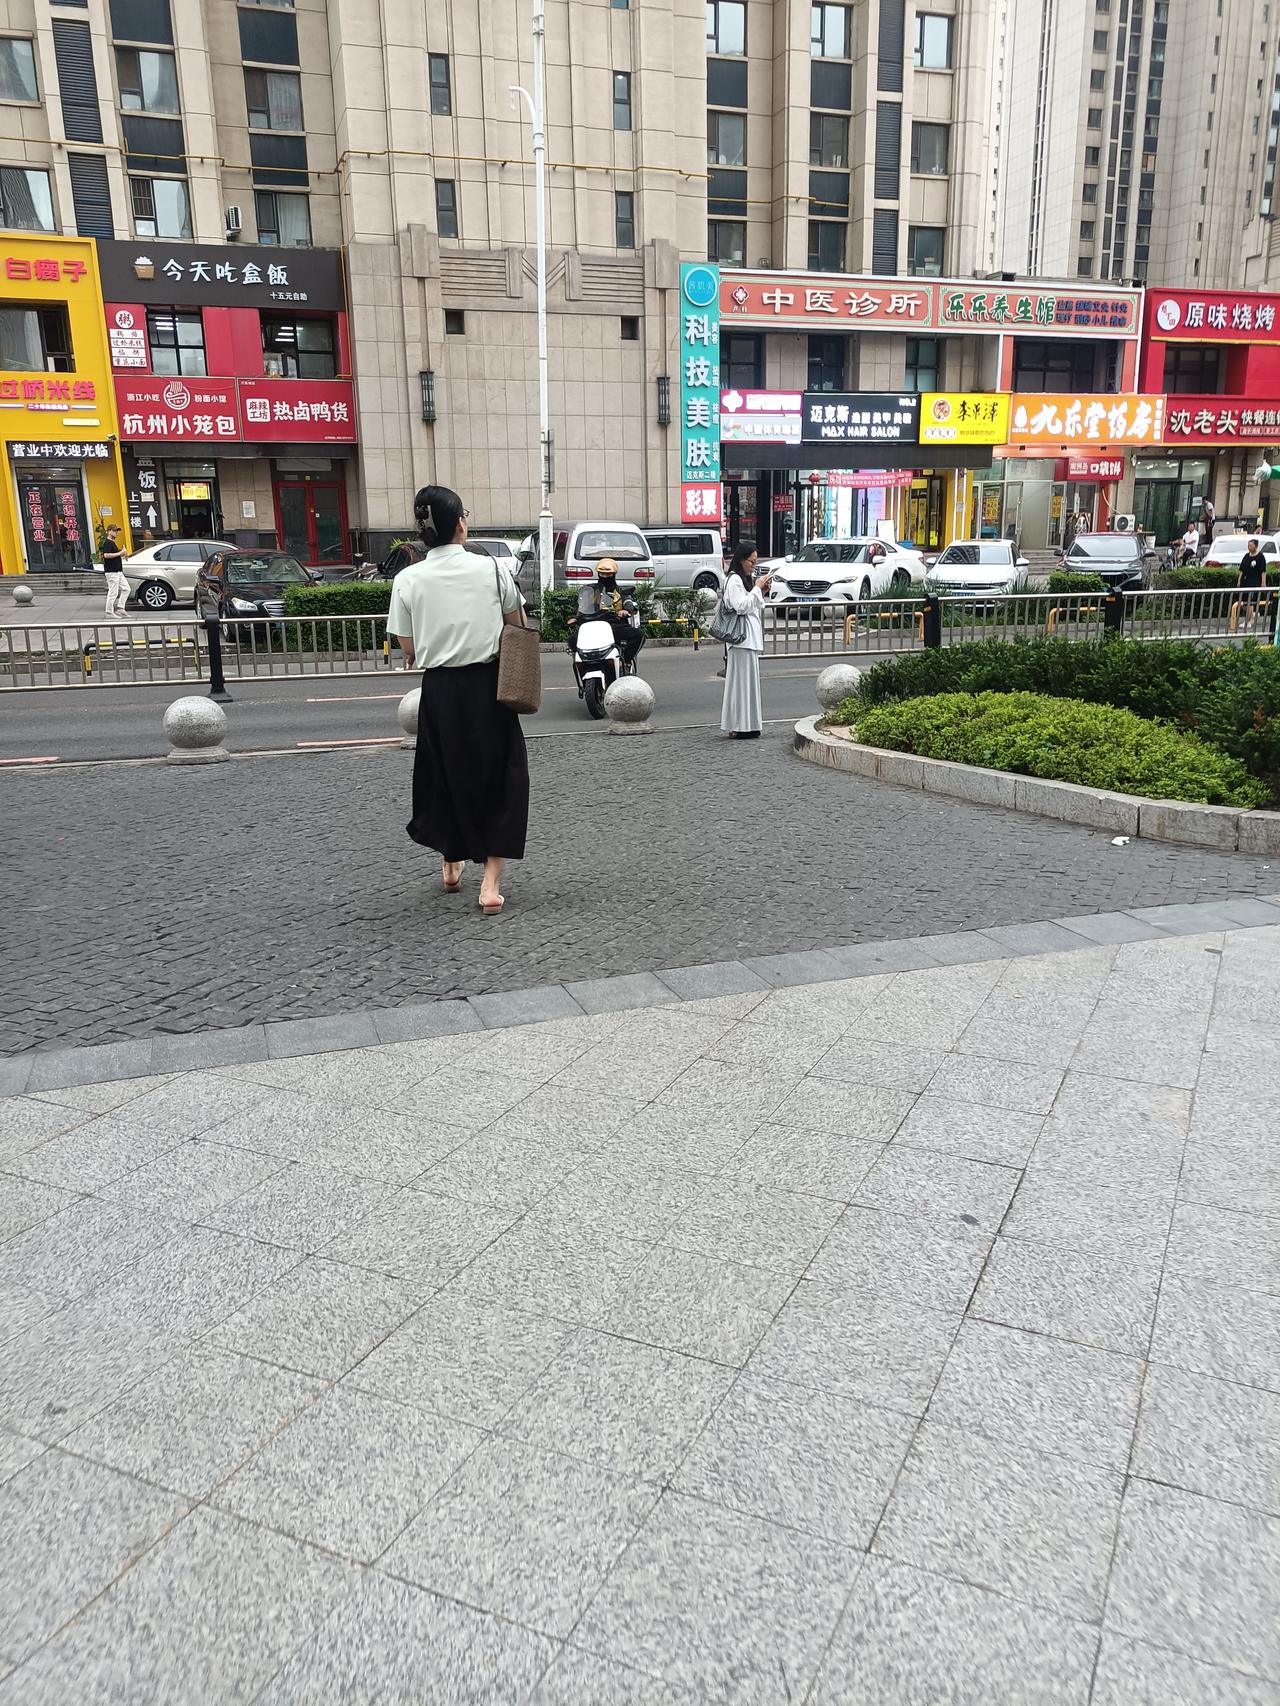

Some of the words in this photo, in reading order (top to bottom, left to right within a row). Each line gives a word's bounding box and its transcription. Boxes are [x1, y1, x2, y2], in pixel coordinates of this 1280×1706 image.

[269, 291, 308, 301] 十五元自助
[761, 287, 923, 317] 中医诊所
[946, 292, 1056, 326] 乐乐养生馆
[1185, 302, 1276, 331] 原味烧烤
[0, 380, 96, 400] 过桥米线
[685, 314, 711, 467] 科技美肤
[249, 400, 269, 410] 麻辣
[273, 400, 349, 422] 热卤鸭货
[810, 405, 849, 423] 迈克斯
[122, 413, 237, 435] 杭州小笼包
[821, 426, 846, 438] MAX
[847, 426, 869, 438] HAIR
[870, 426, 901, 438] SALON
[1171, 409, 1239, 435] 沈老头
[12, 443, 109, 457] 营业中欢迎光临
[129, 491, 142, 528] 上二楼
[685, 489, 717, 516] 彩票
[28, 491, 47, 542] 正在营业
[61, 492, 79, 541] 空调开放
